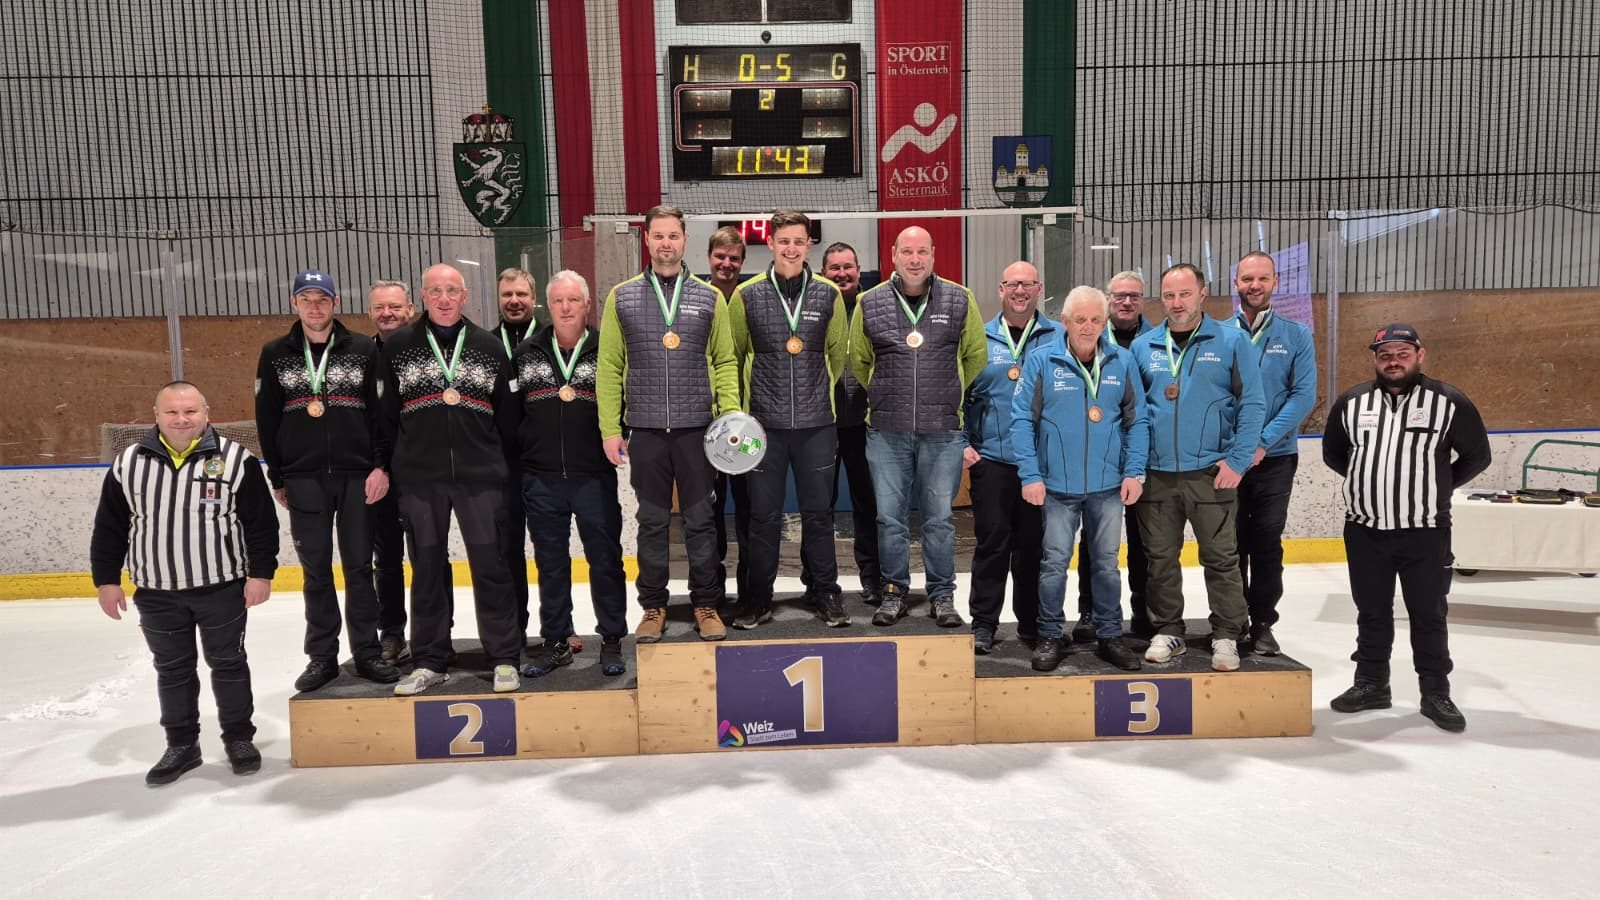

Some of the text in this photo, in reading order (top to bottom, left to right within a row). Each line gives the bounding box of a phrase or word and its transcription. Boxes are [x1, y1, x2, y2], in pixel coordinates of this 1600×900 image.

[887, 45, 949, 62] SPORT
[683, 54, 699, 82] H
[831, 53, 847, 80] G
[888, 64, 949, 75] in Österreich
[760, 91, 772, 109] 2
[888, 161, 949, 185] ASKÖ
[888, 182, 948, 197] Steiermark
[783, 655, 825, 733] 1
[1127, 681, 1160, 733] 3
[447, 702, 484, 755] 2
[743, 720, 775, 735] Weiz
